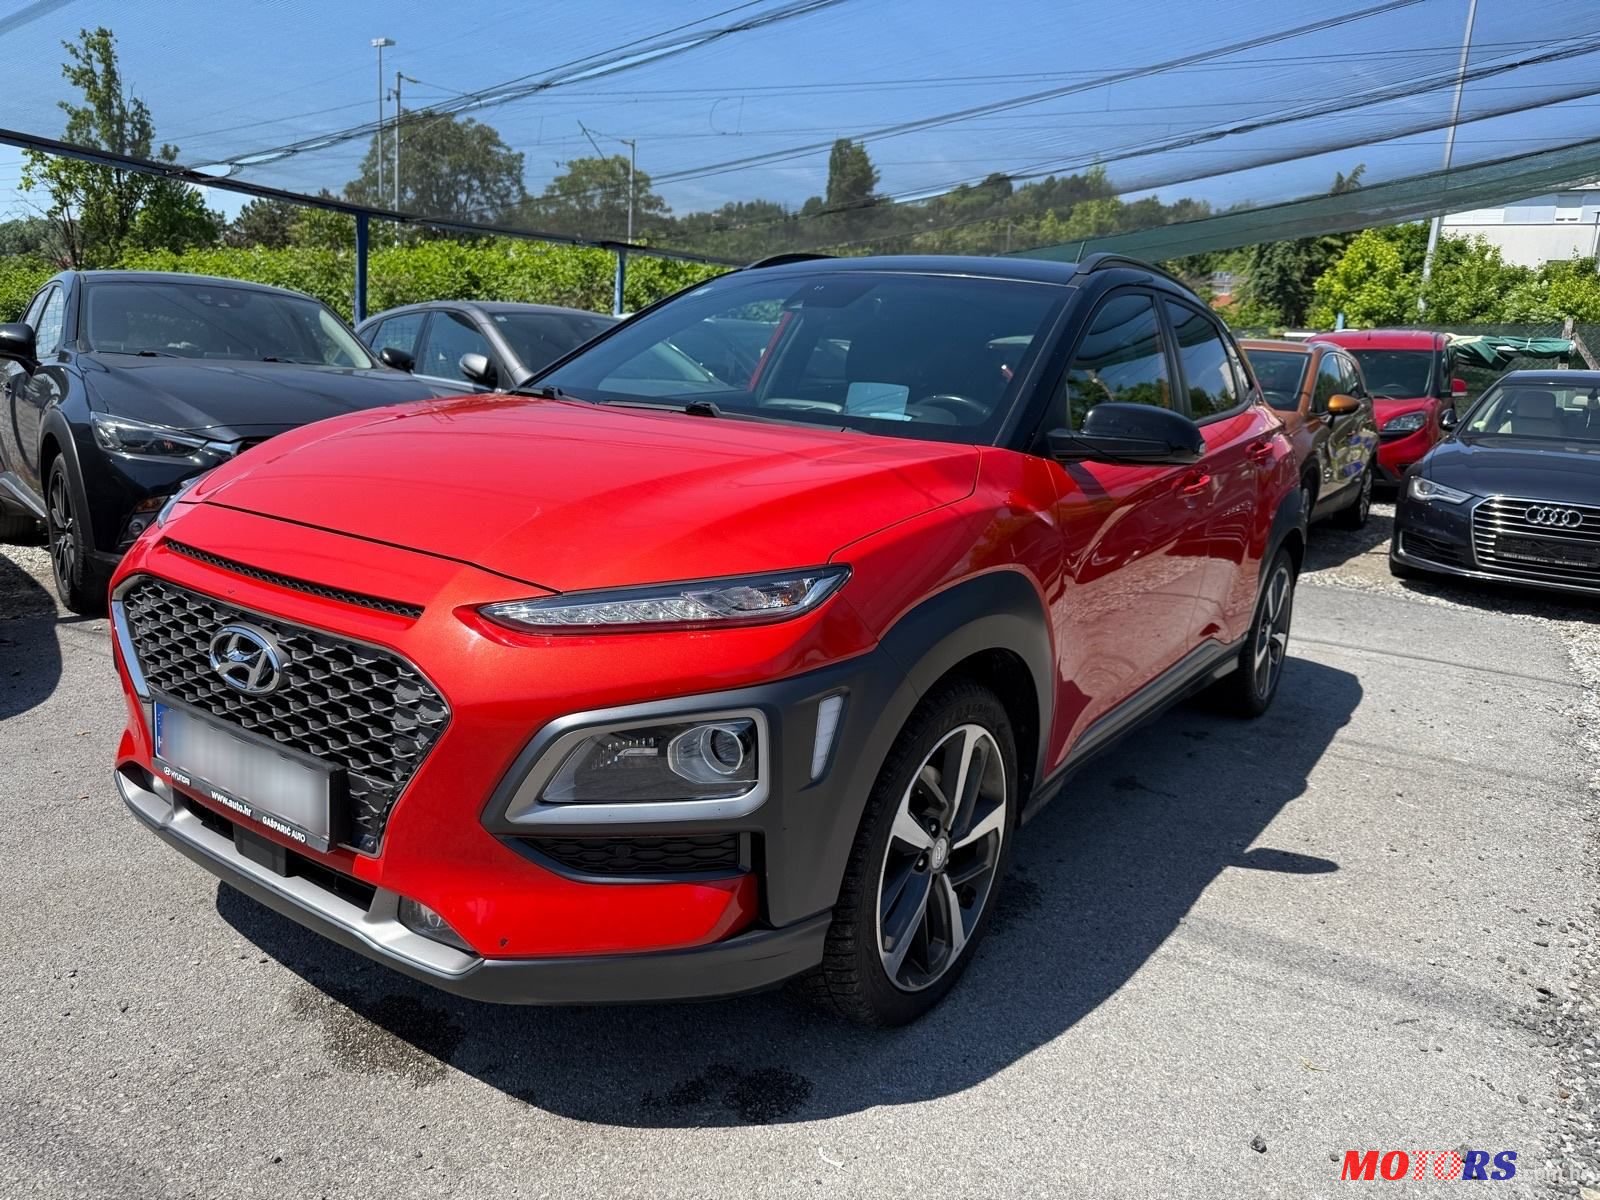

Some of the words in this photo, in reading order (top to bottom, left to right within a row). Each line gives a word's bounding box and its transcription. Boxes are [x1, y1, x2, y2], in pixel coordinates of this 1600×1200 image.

[211, 791, 252, 817] www.auto.hr
[262, 815, 291, 836] GAŠPARIĆ
[291, 830, 306, 843] AUTO
